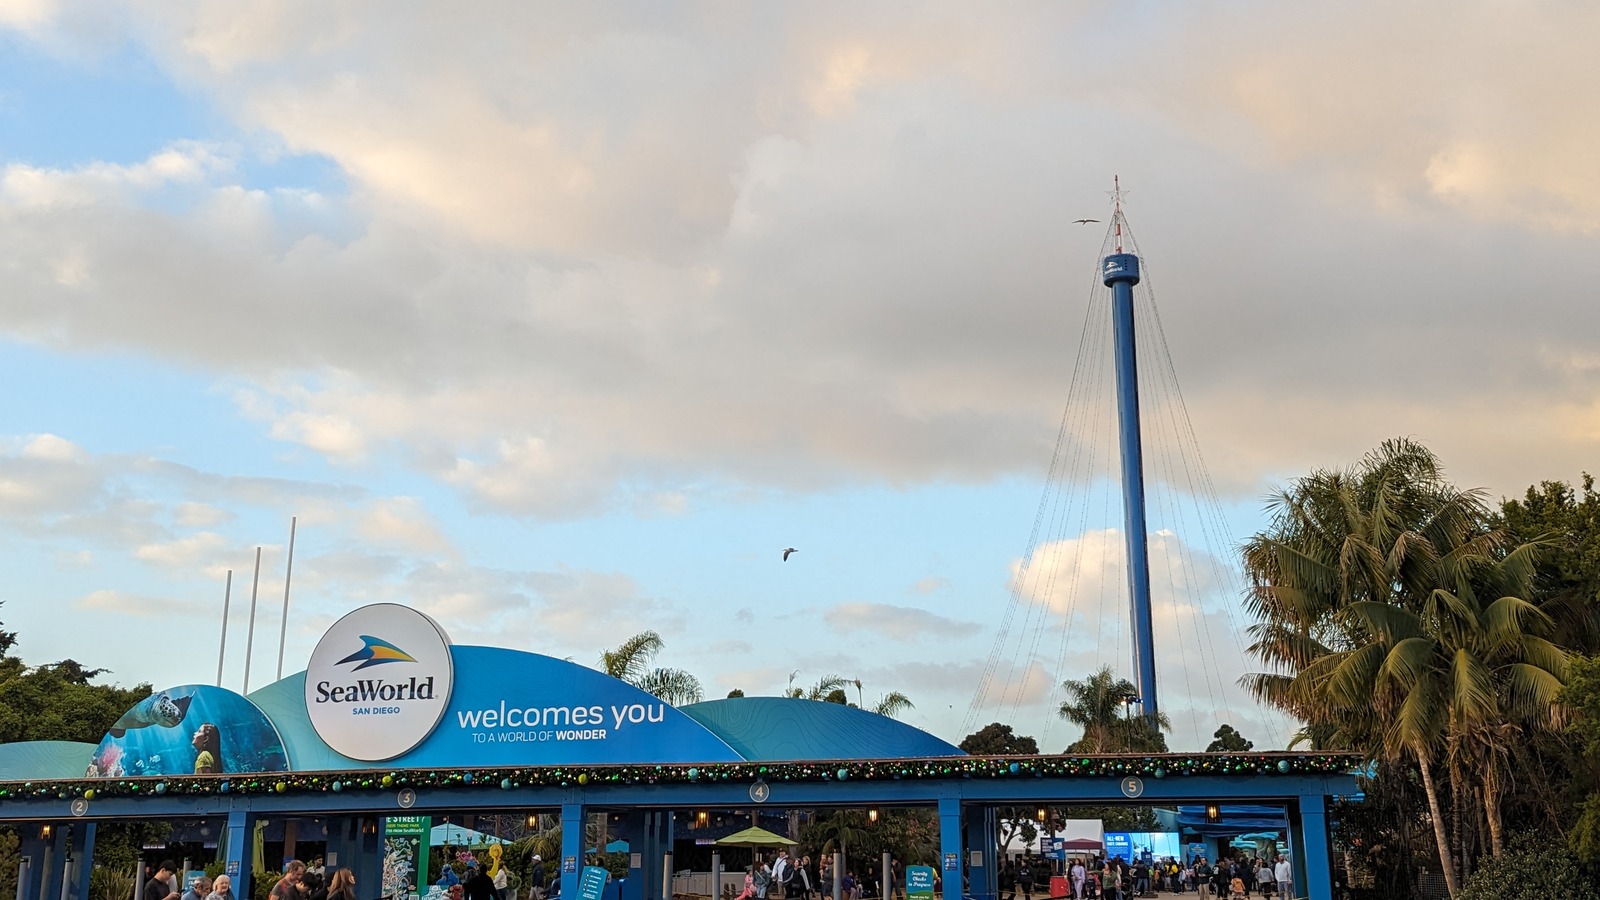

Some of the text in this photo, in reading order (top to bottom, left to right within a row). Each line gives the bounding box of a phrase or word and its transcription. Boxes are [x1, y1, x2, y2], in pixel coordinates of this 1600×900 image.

[315, 676, 435, 703] SeaWorld
[352, 706, 401, 715] SAN DIEGO
[457, 699, 665, 730] welcomes you
[472, 729, 607, 743] TO A WORLD OF WONDER
[754, 786, 764, 797] 4
[1128, 781, 1137, 792] 5
[403, 792, 411, 803] 3
[76, 801, 83, 812] 2
